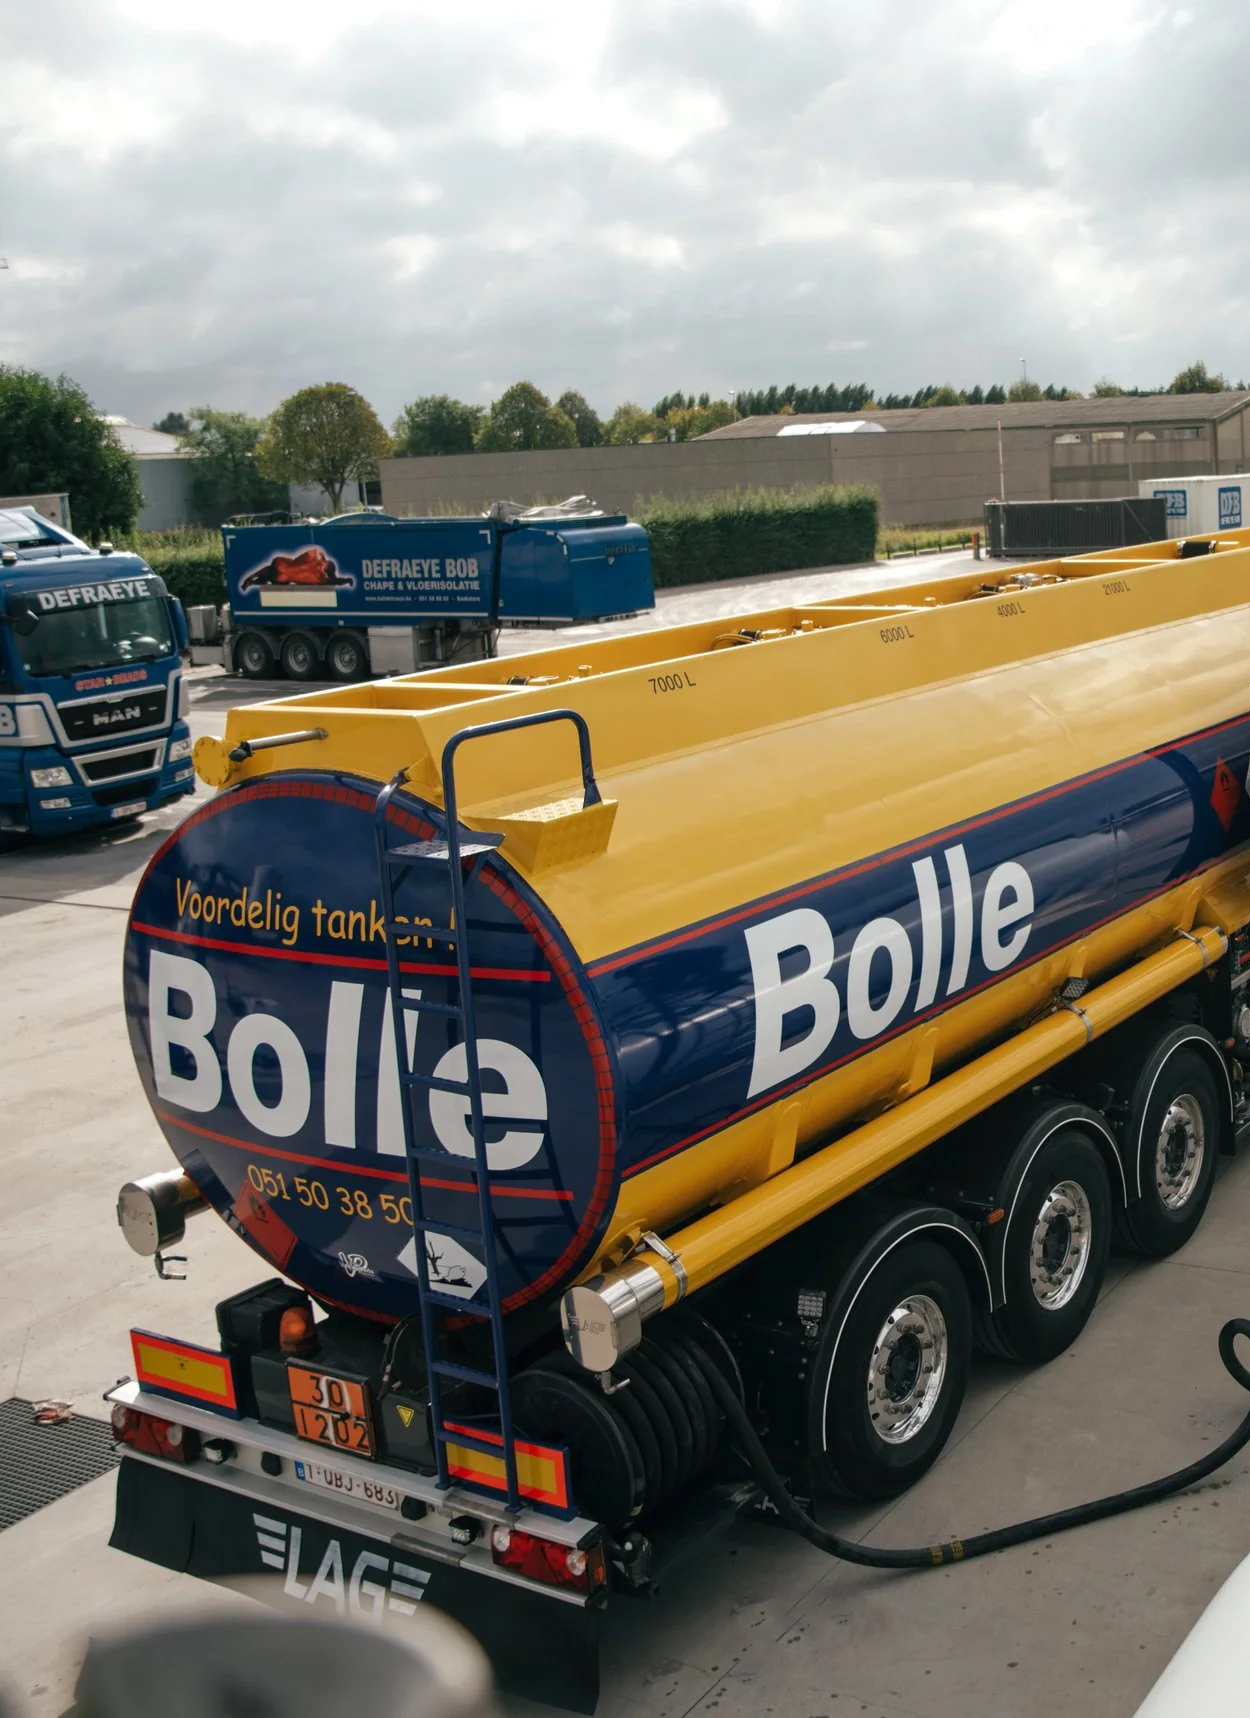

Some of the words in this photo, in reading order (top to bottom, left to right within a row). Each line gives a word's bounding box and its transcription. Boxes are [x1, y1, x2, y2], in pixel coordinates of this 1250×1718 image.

[362, 559, 441, 578] DEFRAEYE
[445, 558, 479, 578] BOB
[37, 580, 150, 610] DEFRAEYE
[363, 581, 395, 590] CHAPE
[397, 581, 404, 590] &
[406, 581, 480, 590] VLOERISOLATIE
[1123, 581, 1131, 592] L
[997, 603, 1016, 619] 4000
[1016, 602, 1026, 614] L
[880, 625, 904, 644] 6000
[904, 624, 915, 639] L
[648, 674, 682, 695] 7000
[682, 672, 697, 689] L
[92, 706, 141, 726] MAN
[176, 877, 300, 946] Voordelig
[311, 899, 433, 949] tanken
[743, 843, 1036, 1099] Bolle
[148, 949, 548, 1171] Bolle
[247, 1163, 291, 1201] 051
[294, 1176, 330, 1211] 50
[336, 1186, 373, 1220] 38
[379, 1193, 414, 1226] 50
[310, 1375, 344, 1407] 30
[300, 1408, 370, 1450] 1202
